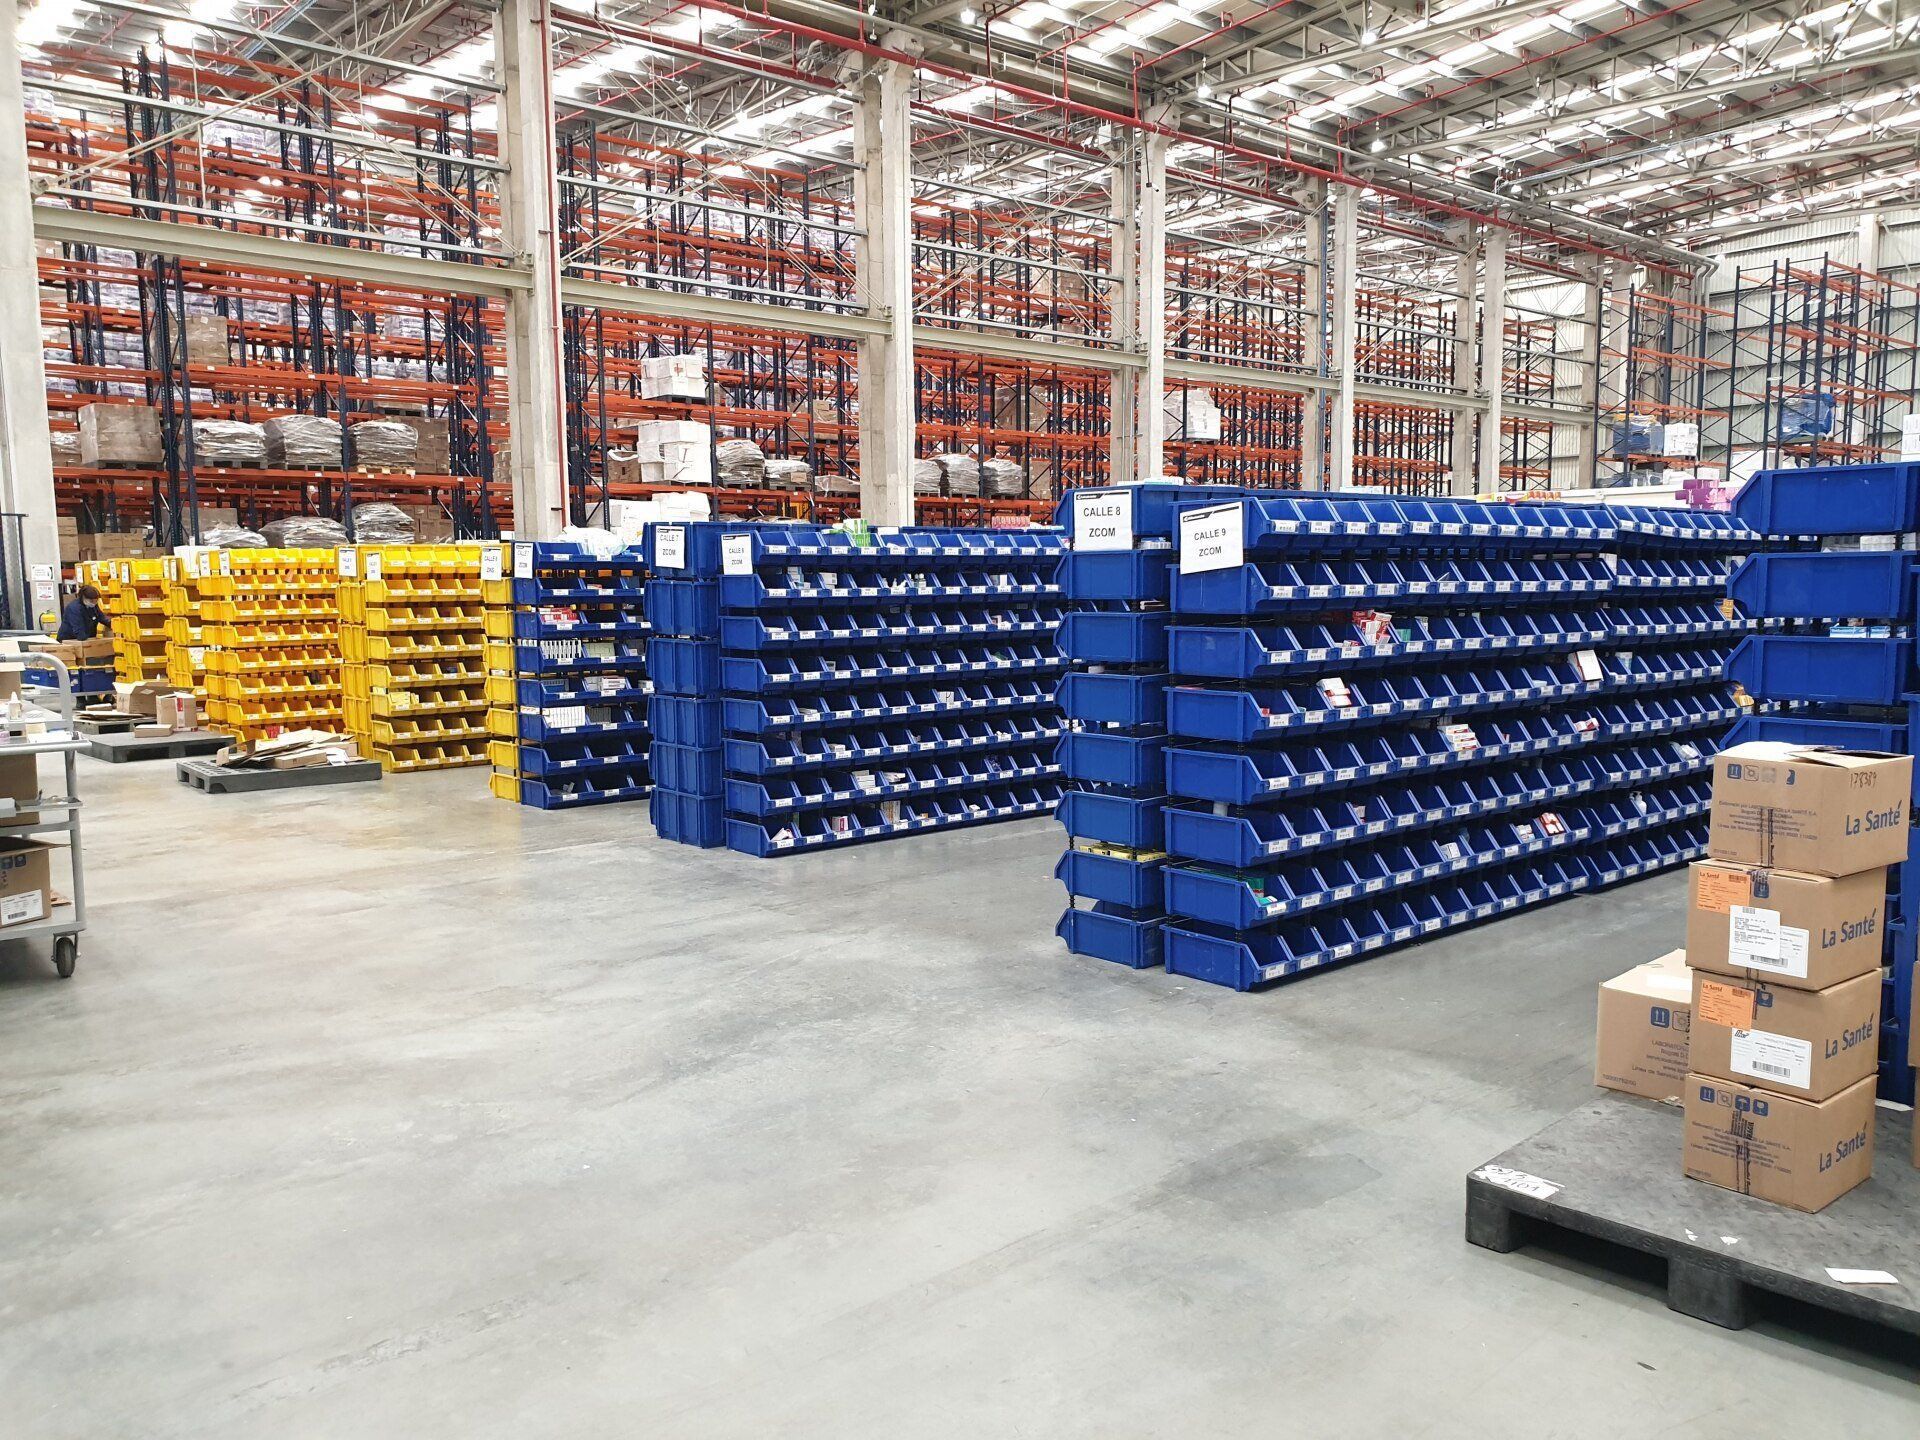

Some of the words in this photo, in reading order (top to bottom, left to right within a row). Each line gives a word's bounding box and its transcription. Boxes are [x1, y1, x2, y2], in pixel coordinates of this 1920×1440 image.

[1083, 506, 1113, 517] CALLE
[1115, 506, 1121, 516] 8
[659, 534, 675, 542] CALLE
[1088, 527, 1116, 538] ZCOM
[1193, 529, 1220, 541] CALLE
[1221, 528, 1226, 537] 9
[662, 548, 676, 556] ZCOM
[1198, 545, 1222, 557] ZCOM
[1845, 814, 1860, 836] La
[1865, 800, 1903, 833] Santé
[1821, 928, 1837, 950] La
[1840, 907, 1877, 943] Santé
[1825, 1038, 1838, 1060] La
[1842, 1012, 1875, 1051] Santé
[1819, 1152, 1832, 1173] La
[1836, 1121, 1868, 1163] Santé
